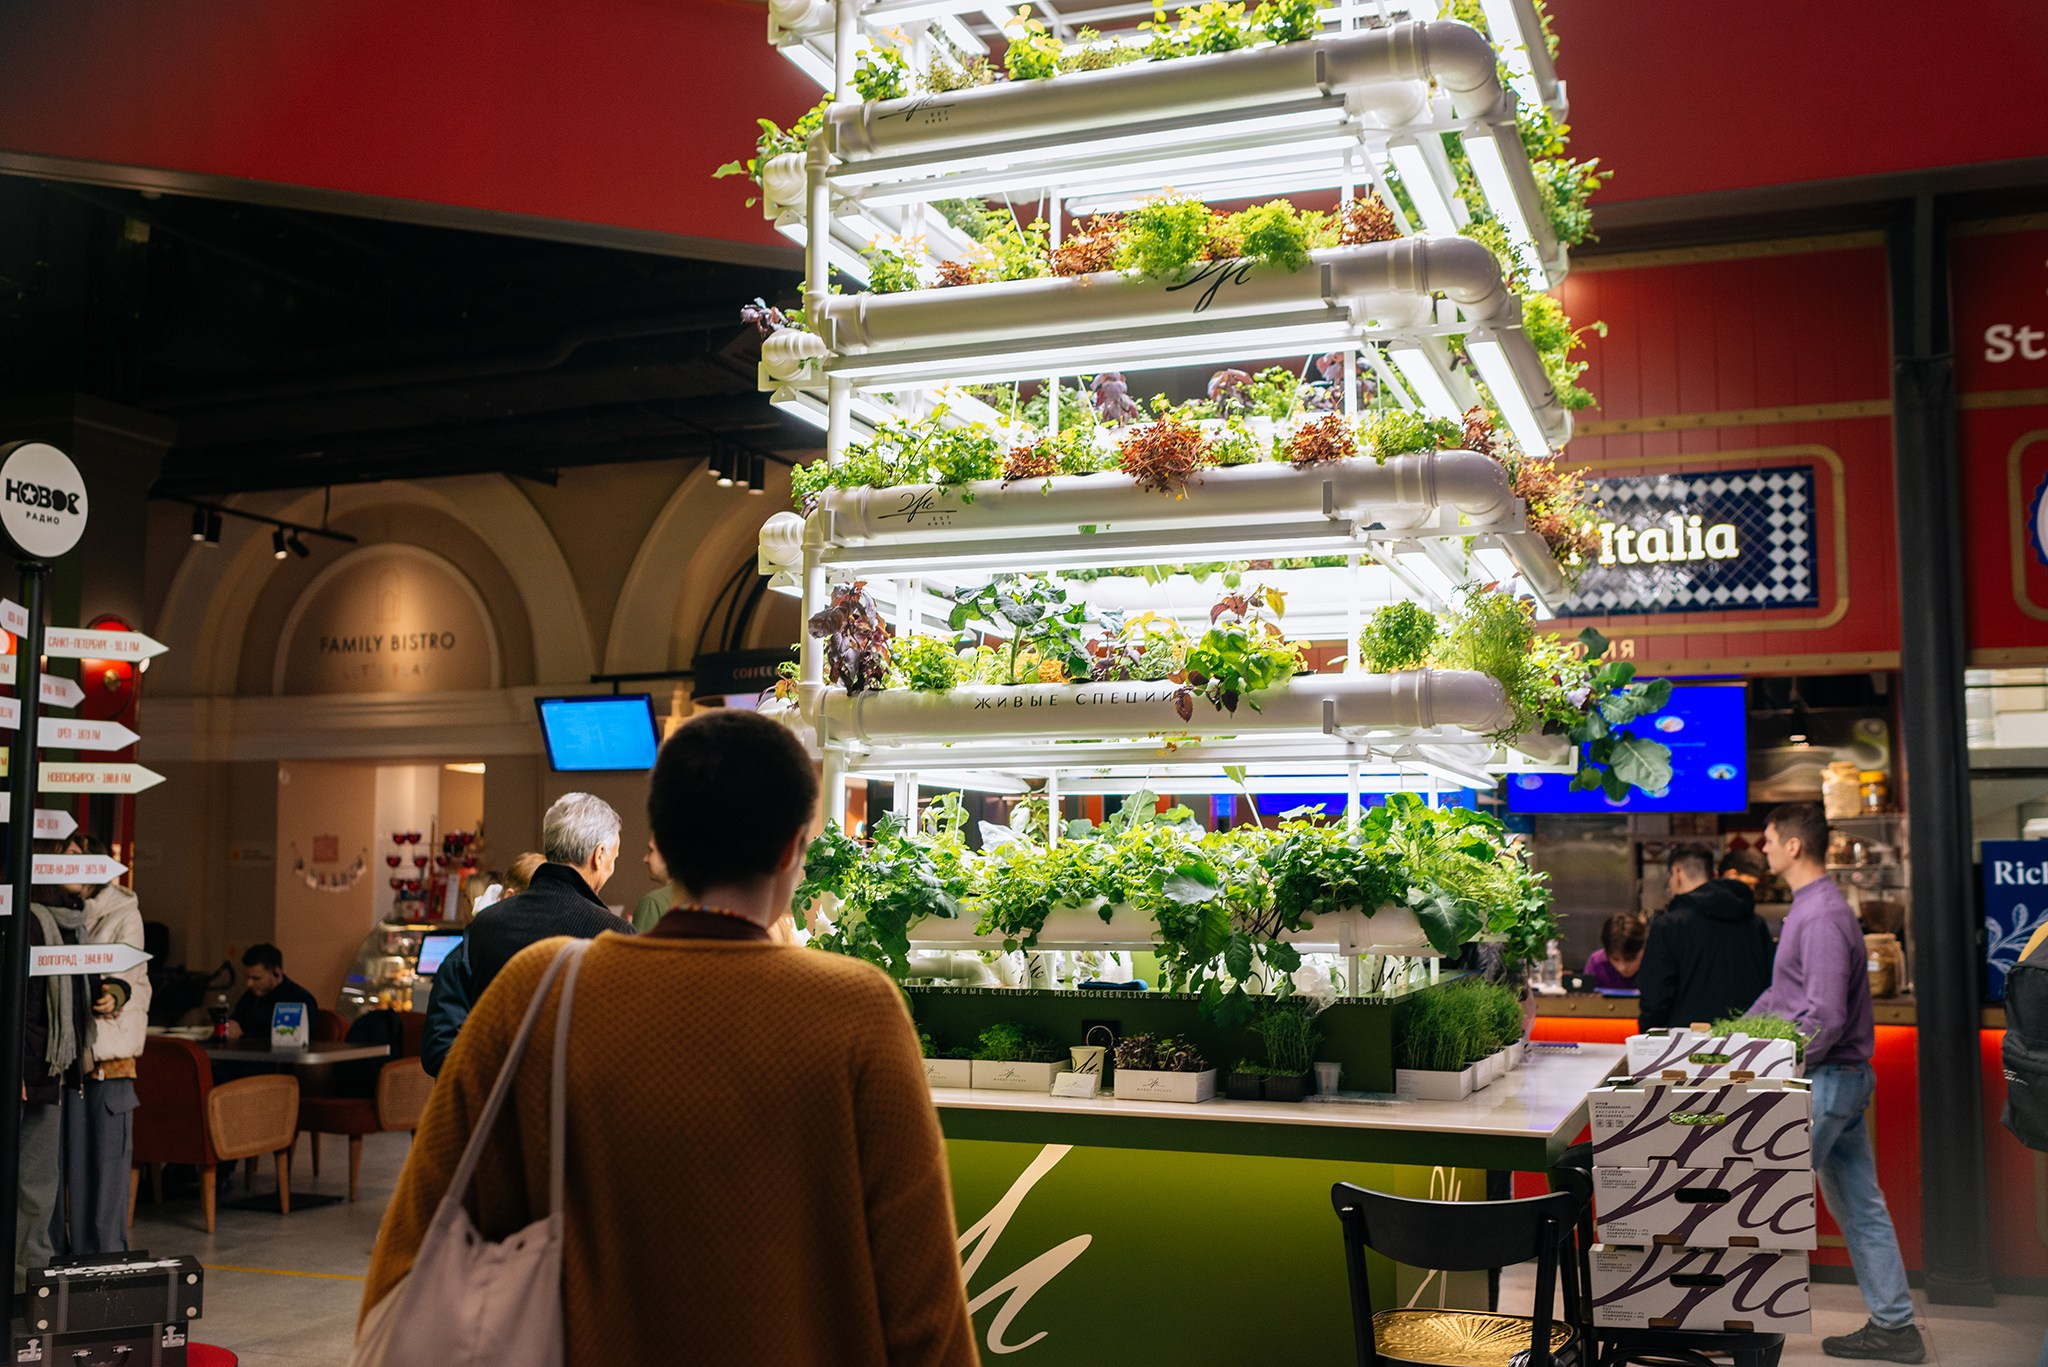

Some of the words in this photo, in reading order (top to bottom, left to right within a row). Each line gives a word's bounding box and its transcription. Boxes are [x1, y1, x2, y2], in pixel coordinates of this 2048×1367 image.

[25, 510, 61, 525] РАДИО
[1597, 514, 1741, 565] Italia
[319, 635, 383, 654] FAMILY
[390, 631, 456, 651] BISTRO
[974, 694, 1058, 710] ЖИВЫЕ
[1075, 691, 1173, 706] СПЕЦИИ
[47, 771, 95, 783] НОВОСИБИРСК
[37, 953, 78, 967] ВОЛГОГРАД
[103, 953, 114, 964] FM
[942, 986, 985, 995] ЖИВЫЕ
[991, 988, 1040, 997] СПЕЦИИ
[1053, 990, 1151, 999] MICROGREEN.LIVE
